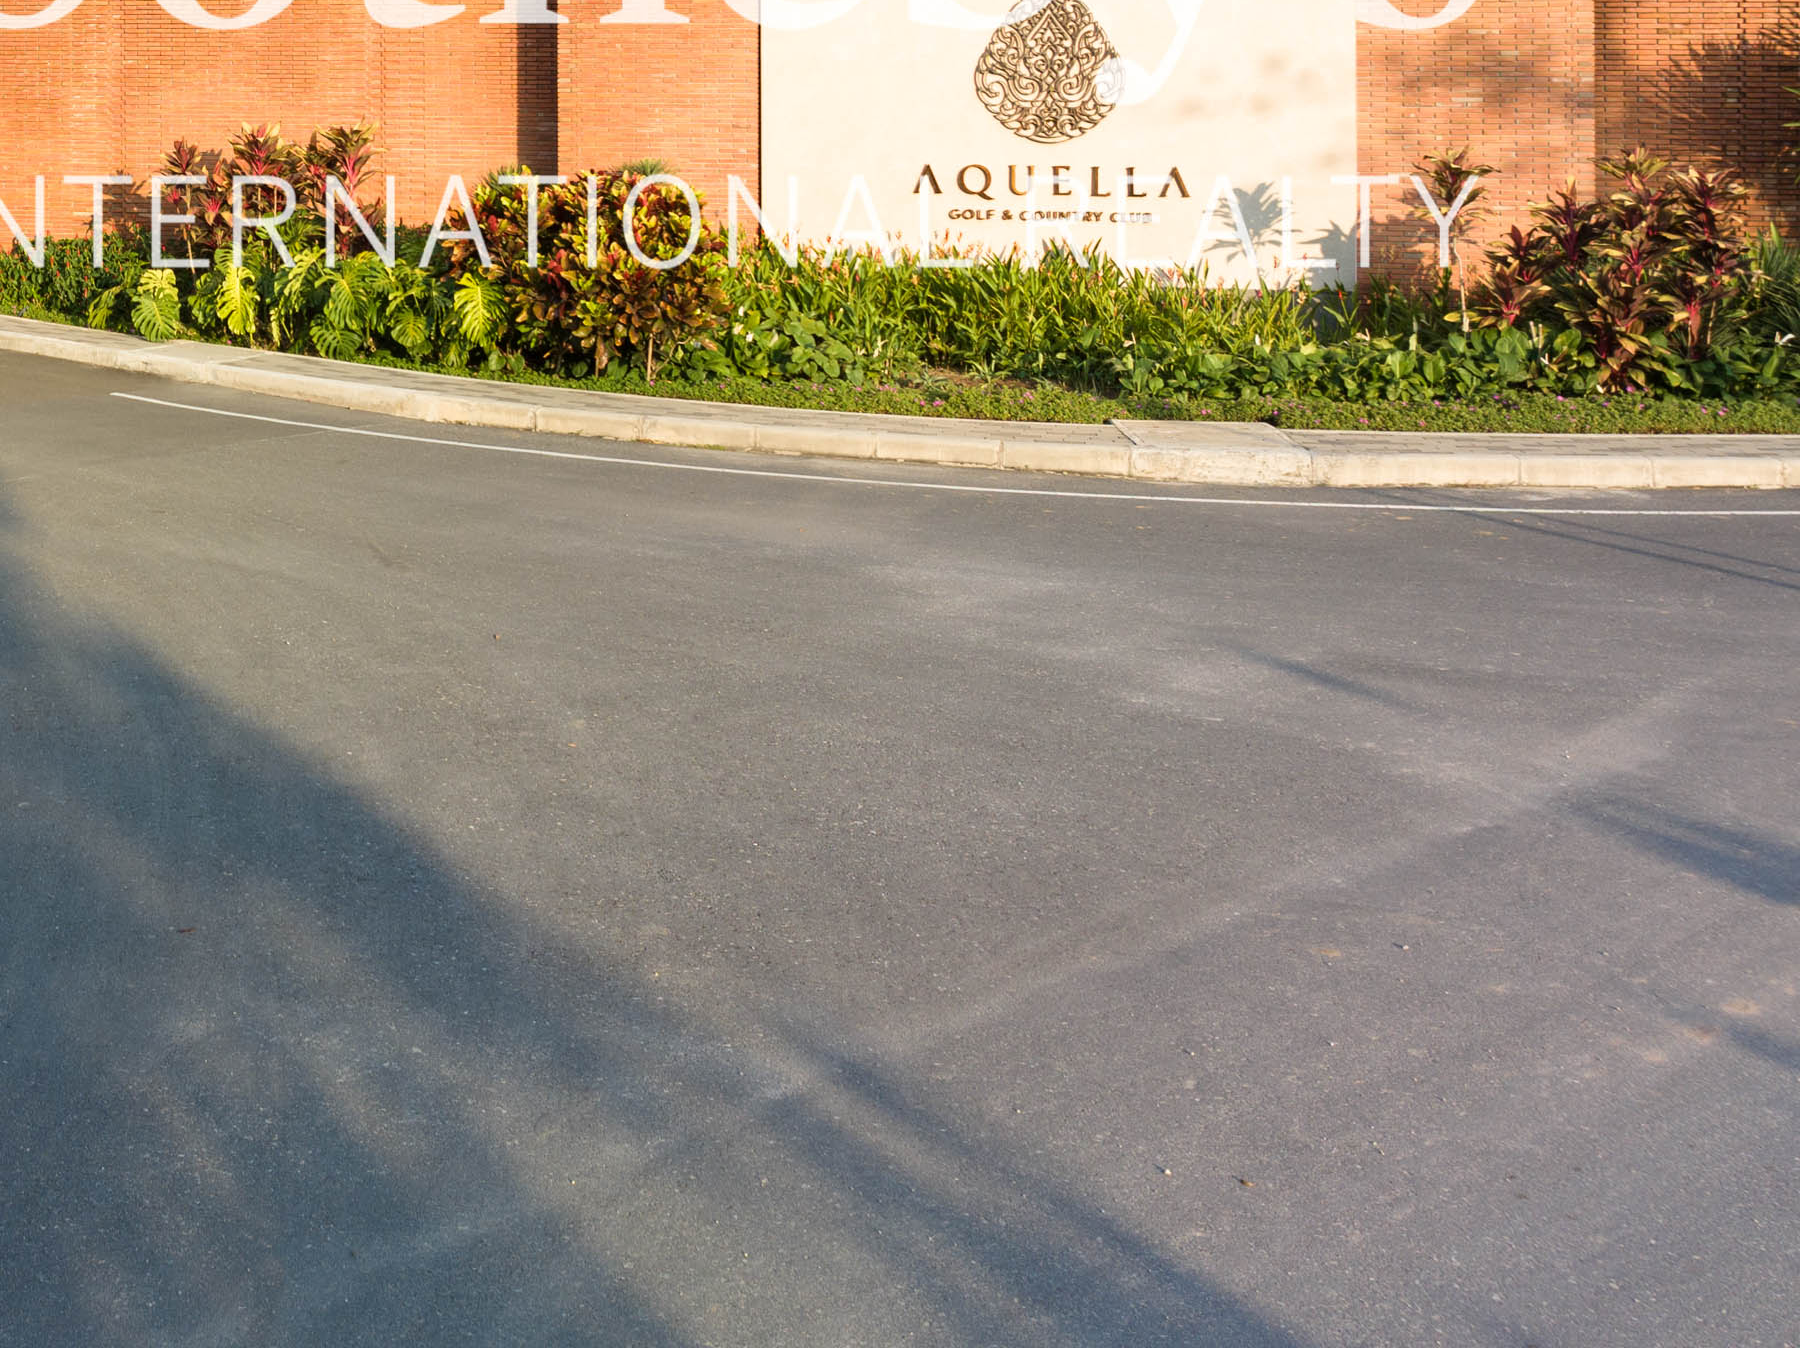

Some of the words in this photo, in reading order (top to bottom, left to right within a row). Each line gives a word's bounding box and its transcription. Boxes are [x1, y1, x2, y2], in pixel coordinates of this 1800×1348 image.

[913, 163, 1191, 201] AQUELLA
[948, 207, 996, 221] GOLF
[1001, 208, 1014, 221] &
